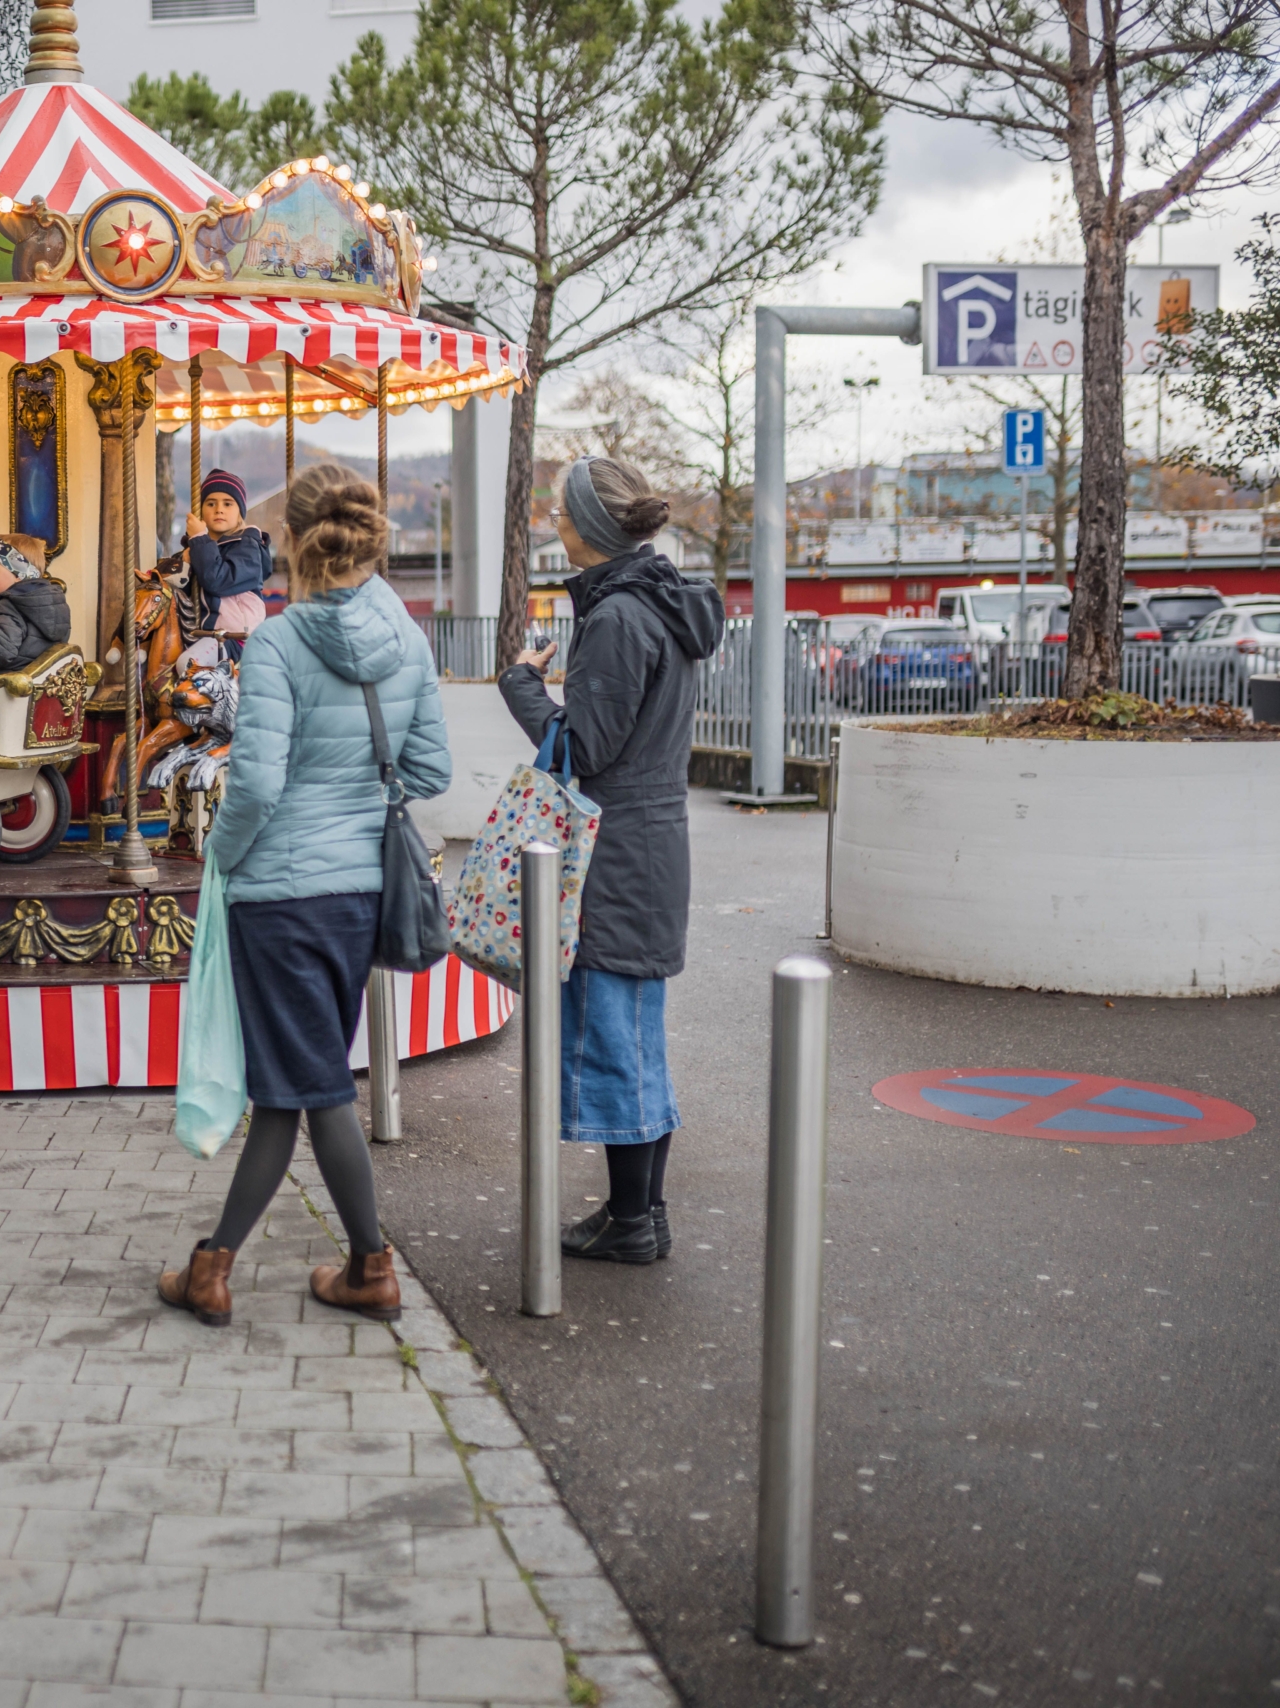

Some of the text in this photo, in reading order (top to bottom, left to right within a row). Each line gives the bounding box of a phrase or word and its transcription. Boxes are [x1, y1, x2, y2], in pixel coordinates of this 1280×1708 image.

[1023, 290, 1143, 324] tägik
[958, 300, 997, 364] P
[1016, 412, 1034, 443] P
